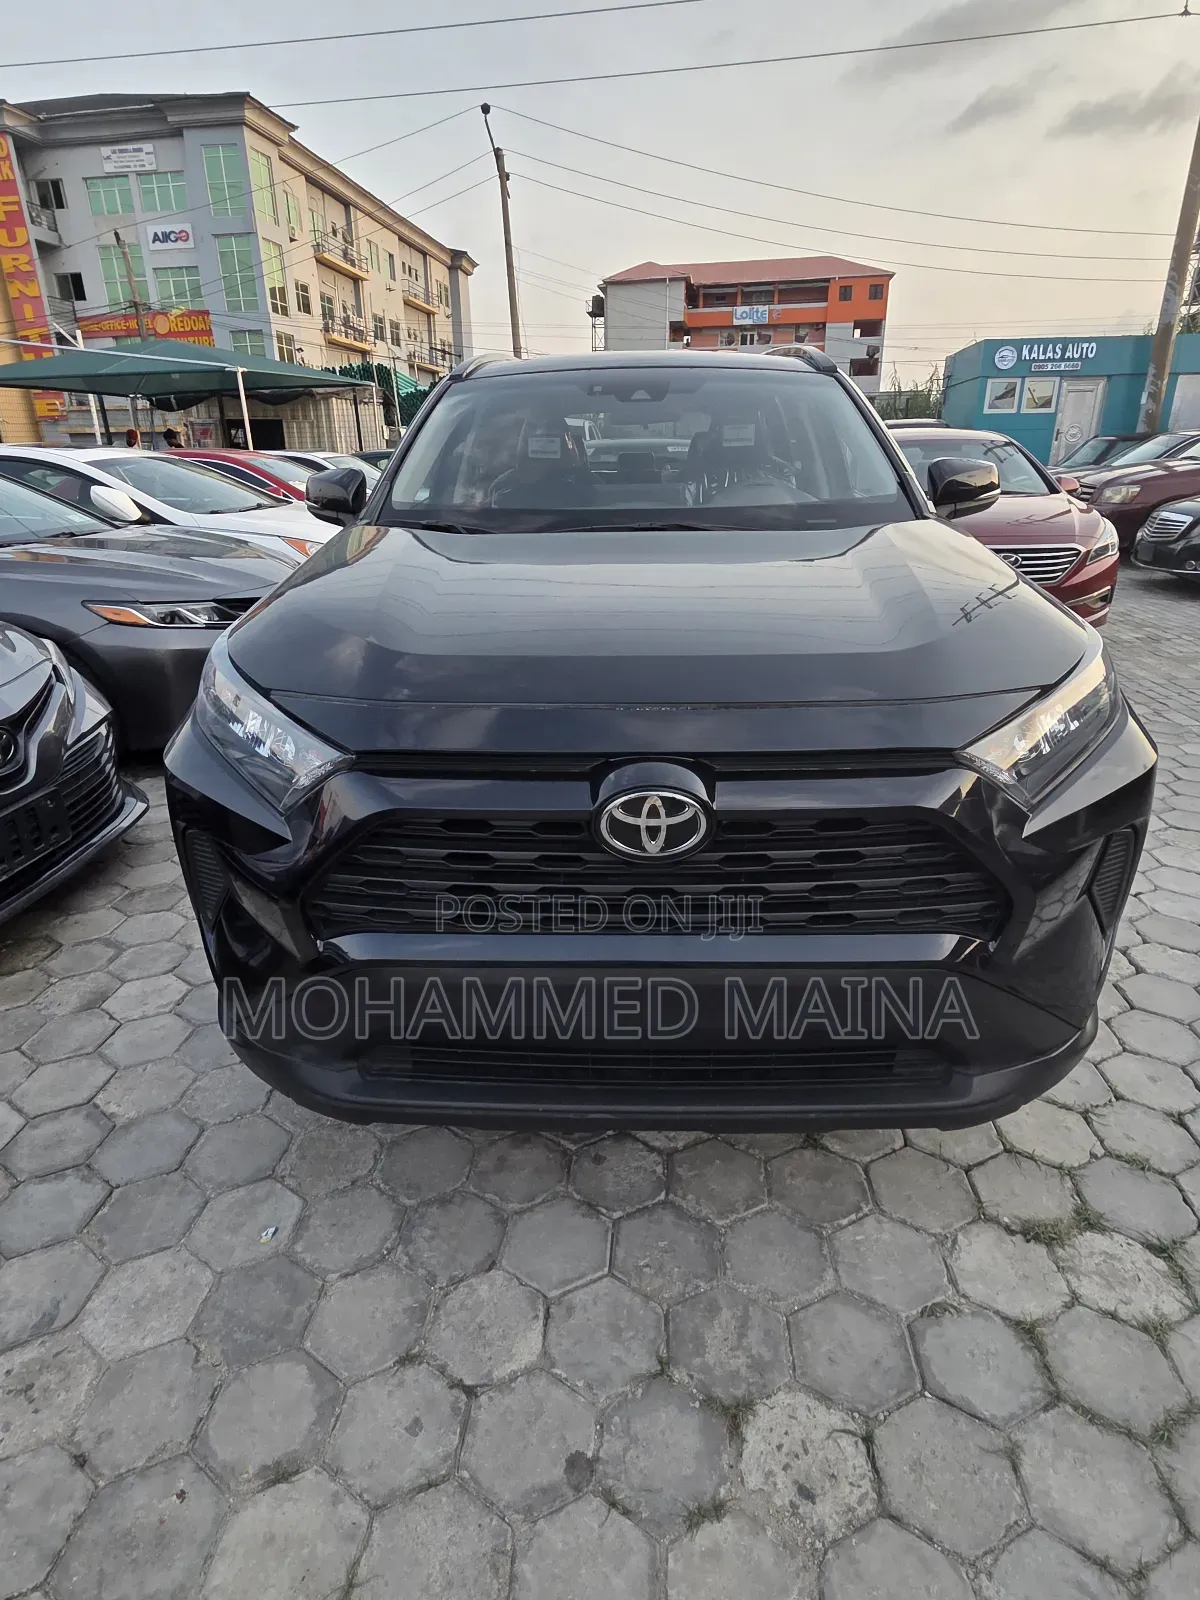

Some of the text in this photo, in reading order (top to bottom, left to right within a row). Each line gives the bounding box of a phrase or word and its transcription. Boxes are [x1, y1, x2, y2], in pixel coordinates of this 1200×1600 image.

[0, 196, 67, 417] FURNITE
[128, 318, 154, 330] HOEL
[1022, 342, 1097, 360] KALAS AUTO
